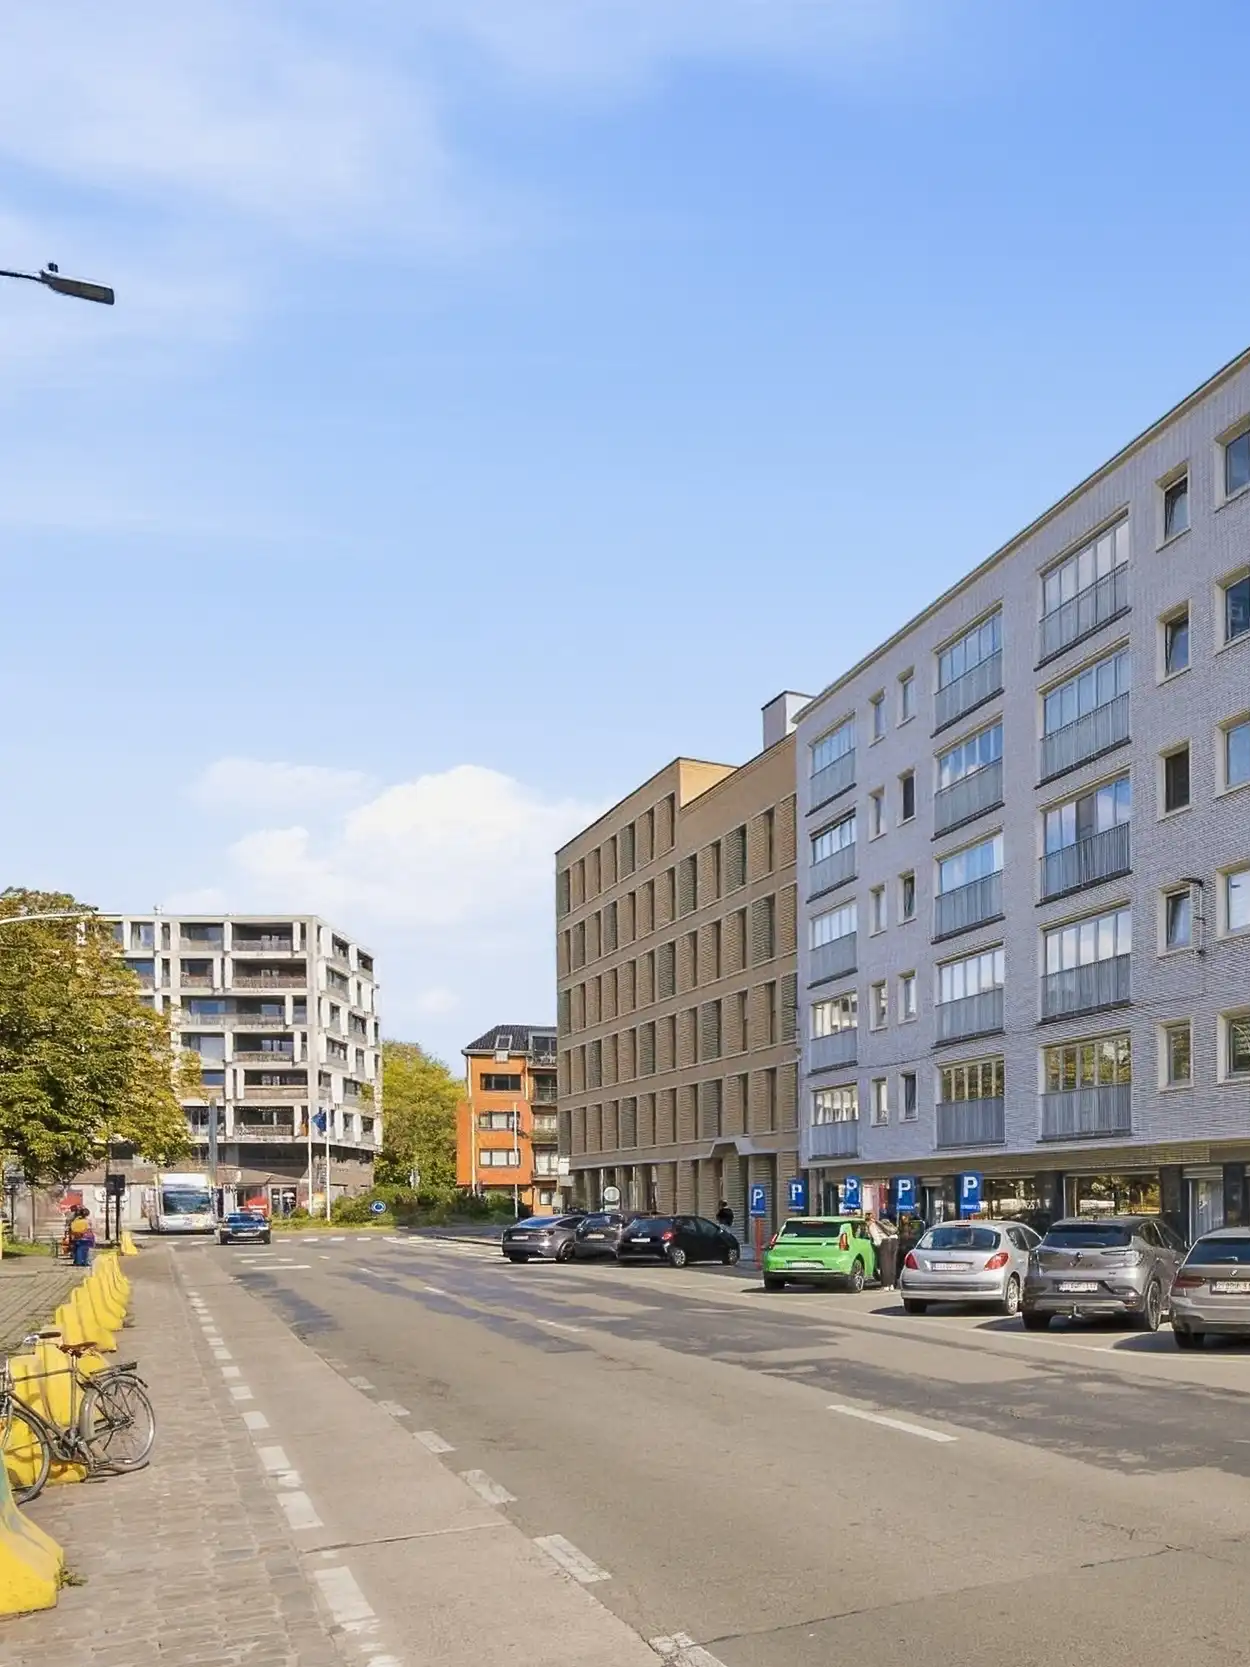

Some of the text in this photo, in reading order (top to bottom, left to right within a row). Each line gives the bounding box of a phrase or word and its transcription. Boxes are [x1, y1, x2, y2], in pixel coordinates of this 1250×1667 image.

[791, 1183, 803, 1201] P
[898, 1179, 911, 1199] P
[963, 1176, 978, 1198] P
[752, 1188, 764, 1206] P
